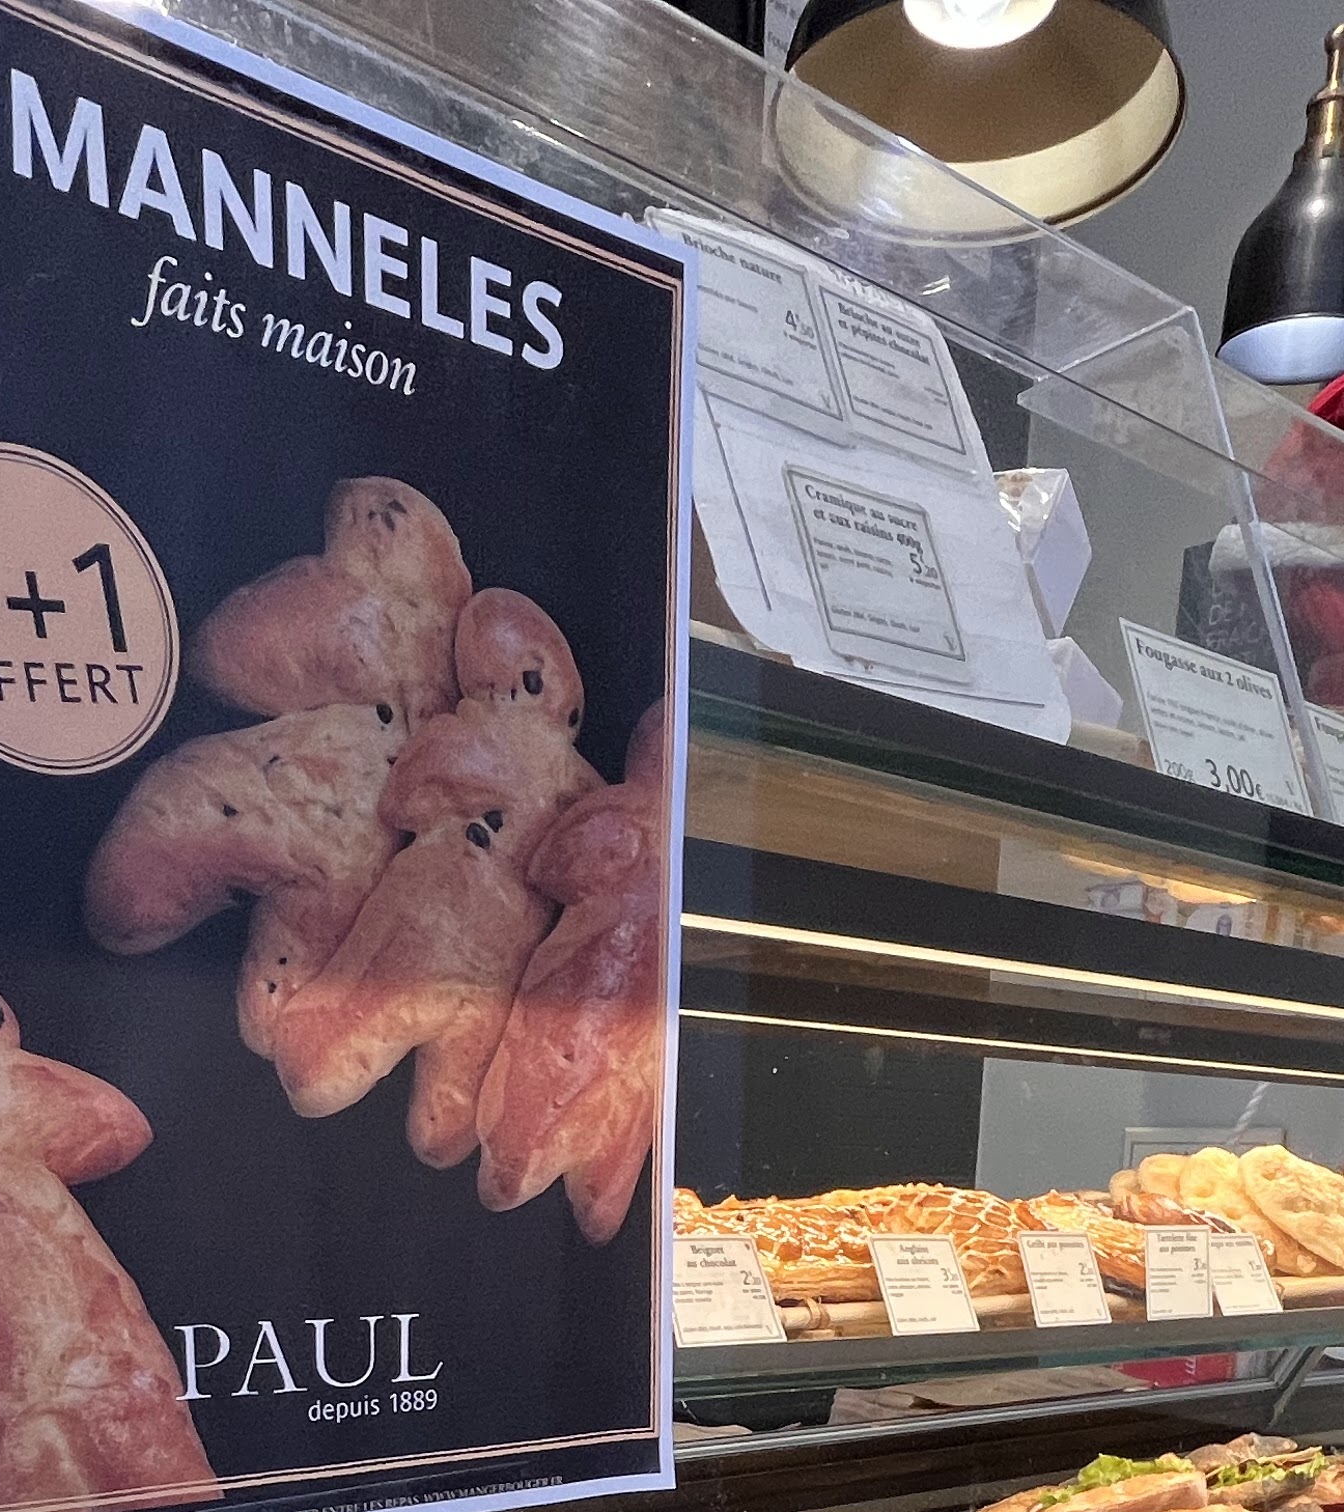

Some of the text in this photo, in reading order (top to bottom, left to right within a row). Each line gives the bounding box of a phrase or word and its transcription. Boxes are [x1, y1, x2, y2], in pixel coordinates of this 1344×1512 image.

[10, 68, 565, 371] MANNELES
[131, 254, 418, 397] faits maison
[1135, 637, 1197, 675] Fougasse
[1201, 658, 1225, 685] aux
[1225, 671, 1234, 686] 2
[1236, 676, 1273, 700] olives
[173, 1313, 444, 1401] PAUL
[307, 1388, 438, 1423] depuis 1889
